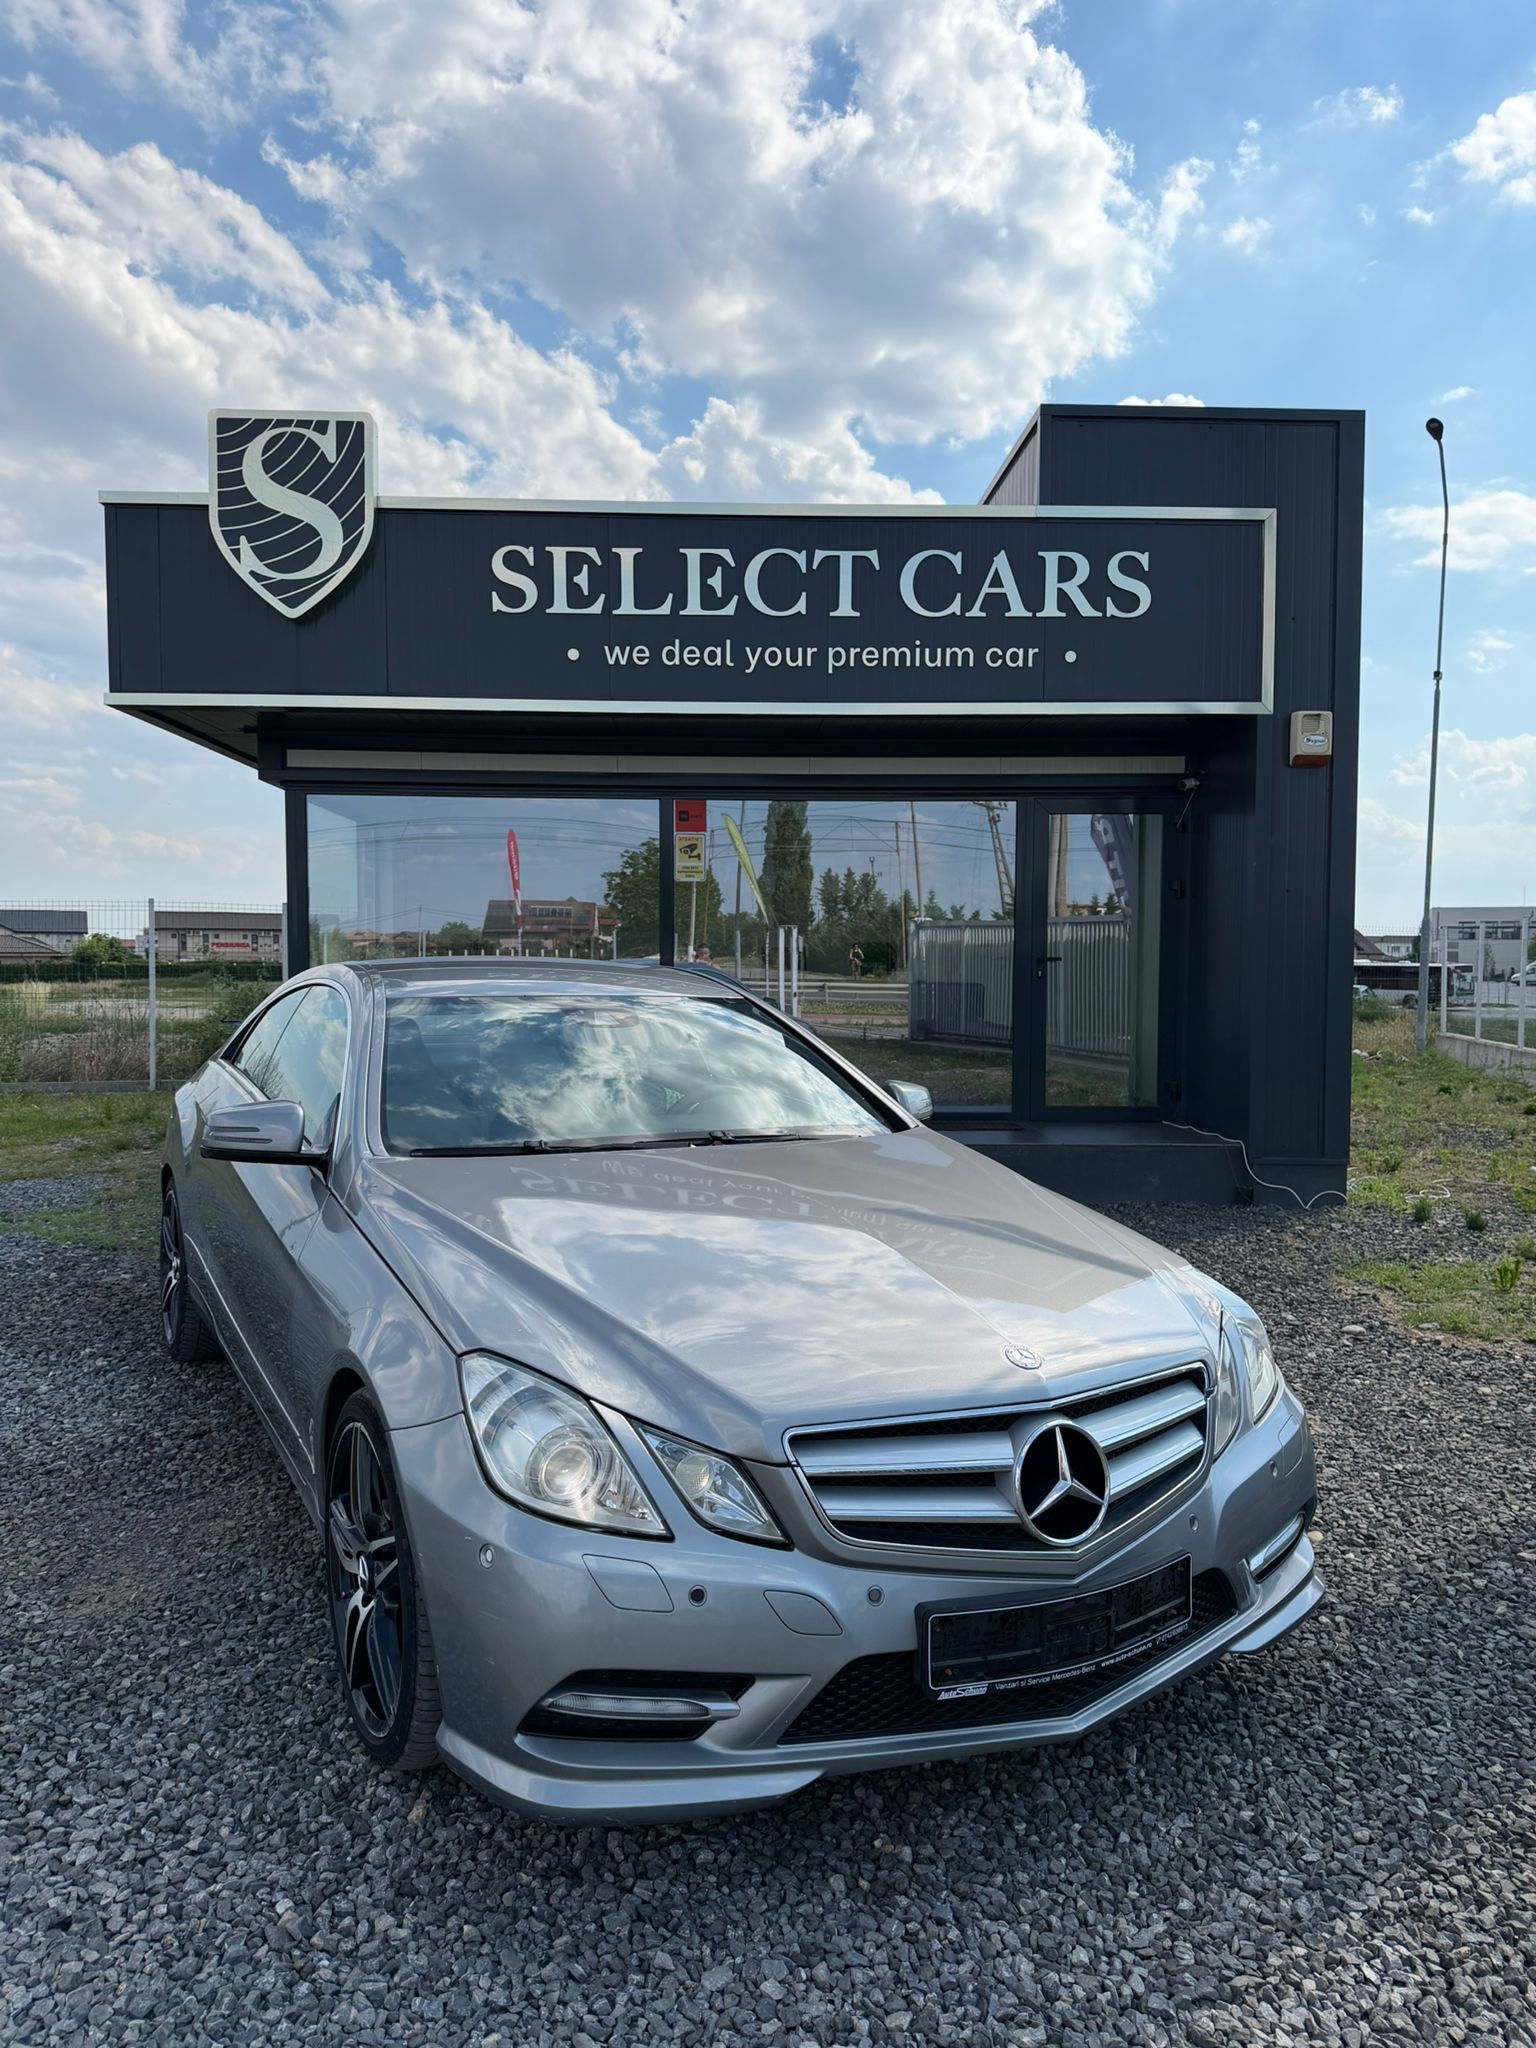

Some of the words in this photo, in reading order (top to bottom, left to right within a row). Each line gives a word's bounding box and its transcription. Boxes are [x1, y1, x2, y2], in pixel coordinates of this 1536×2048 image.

[242, 420, 343, 580] S
[491, 544, 880, 617] SELECT
[899, 549, 1152, 618] CARS
[604, 645, 650, 666] we
[661, 638, 734, 667] deal
[745, 646, 818, 673] your
[828, 640, 975, 674] premium
[985, 646, 1039, 668] car
[1027, 1676, 1050, 1686] Service
[1051, 1664, 1096, 1681] Mercedes-Benz
